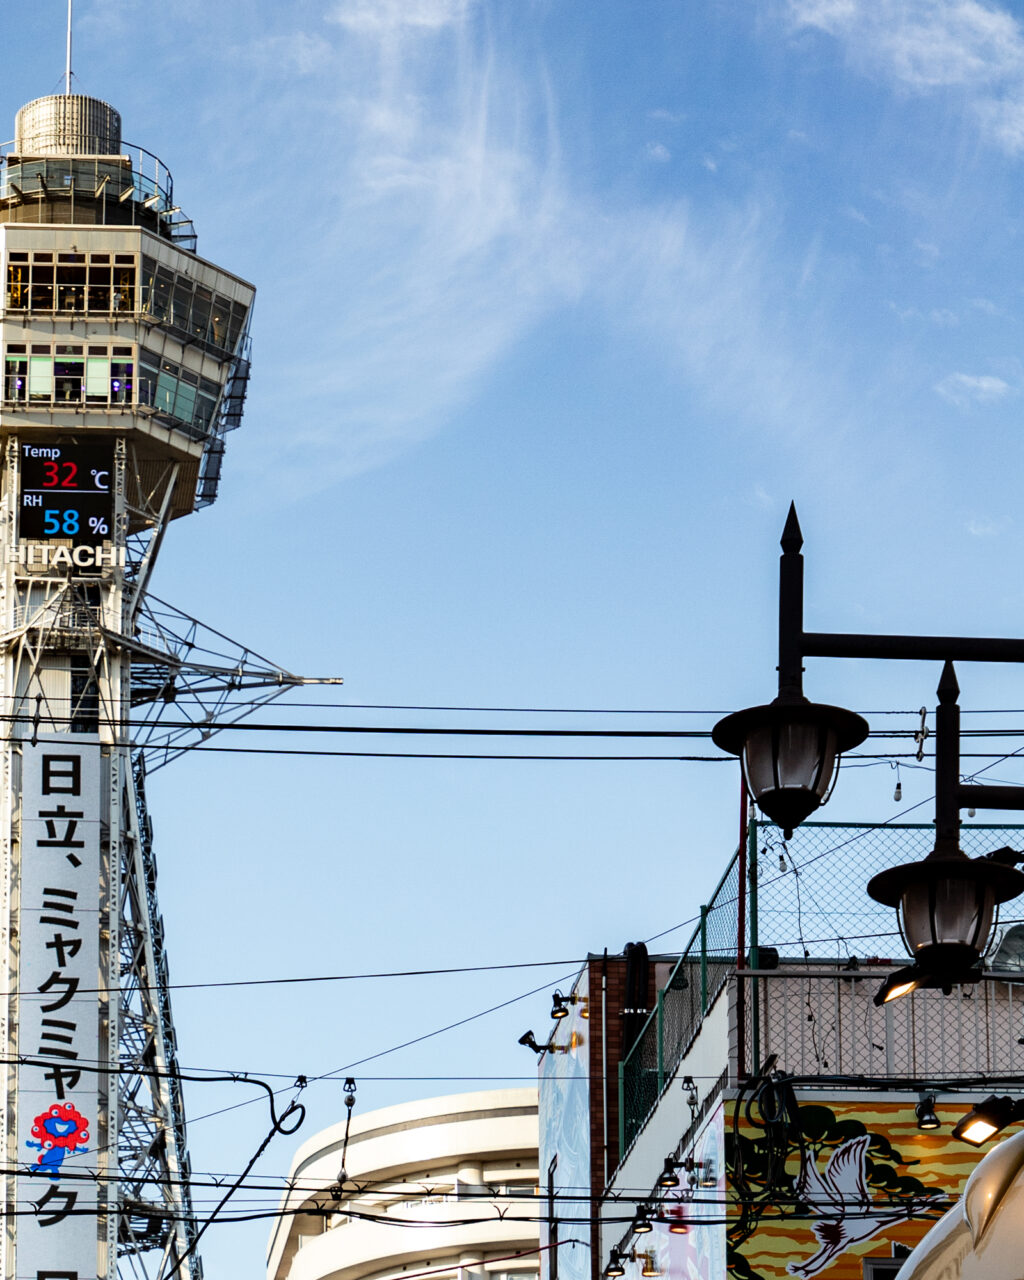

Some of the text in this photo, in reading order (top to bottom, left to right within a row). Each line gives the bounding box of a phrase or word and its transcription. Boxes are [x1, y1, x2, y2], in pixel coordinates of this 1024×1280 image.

[23, 445, 60, 460] Temp
[42, 461, 78, 488] 32
[23, 495, 43, 507] RH
[44, 510, 108, 535] 58 %
[5, 545, 126, 567] HITACHI
